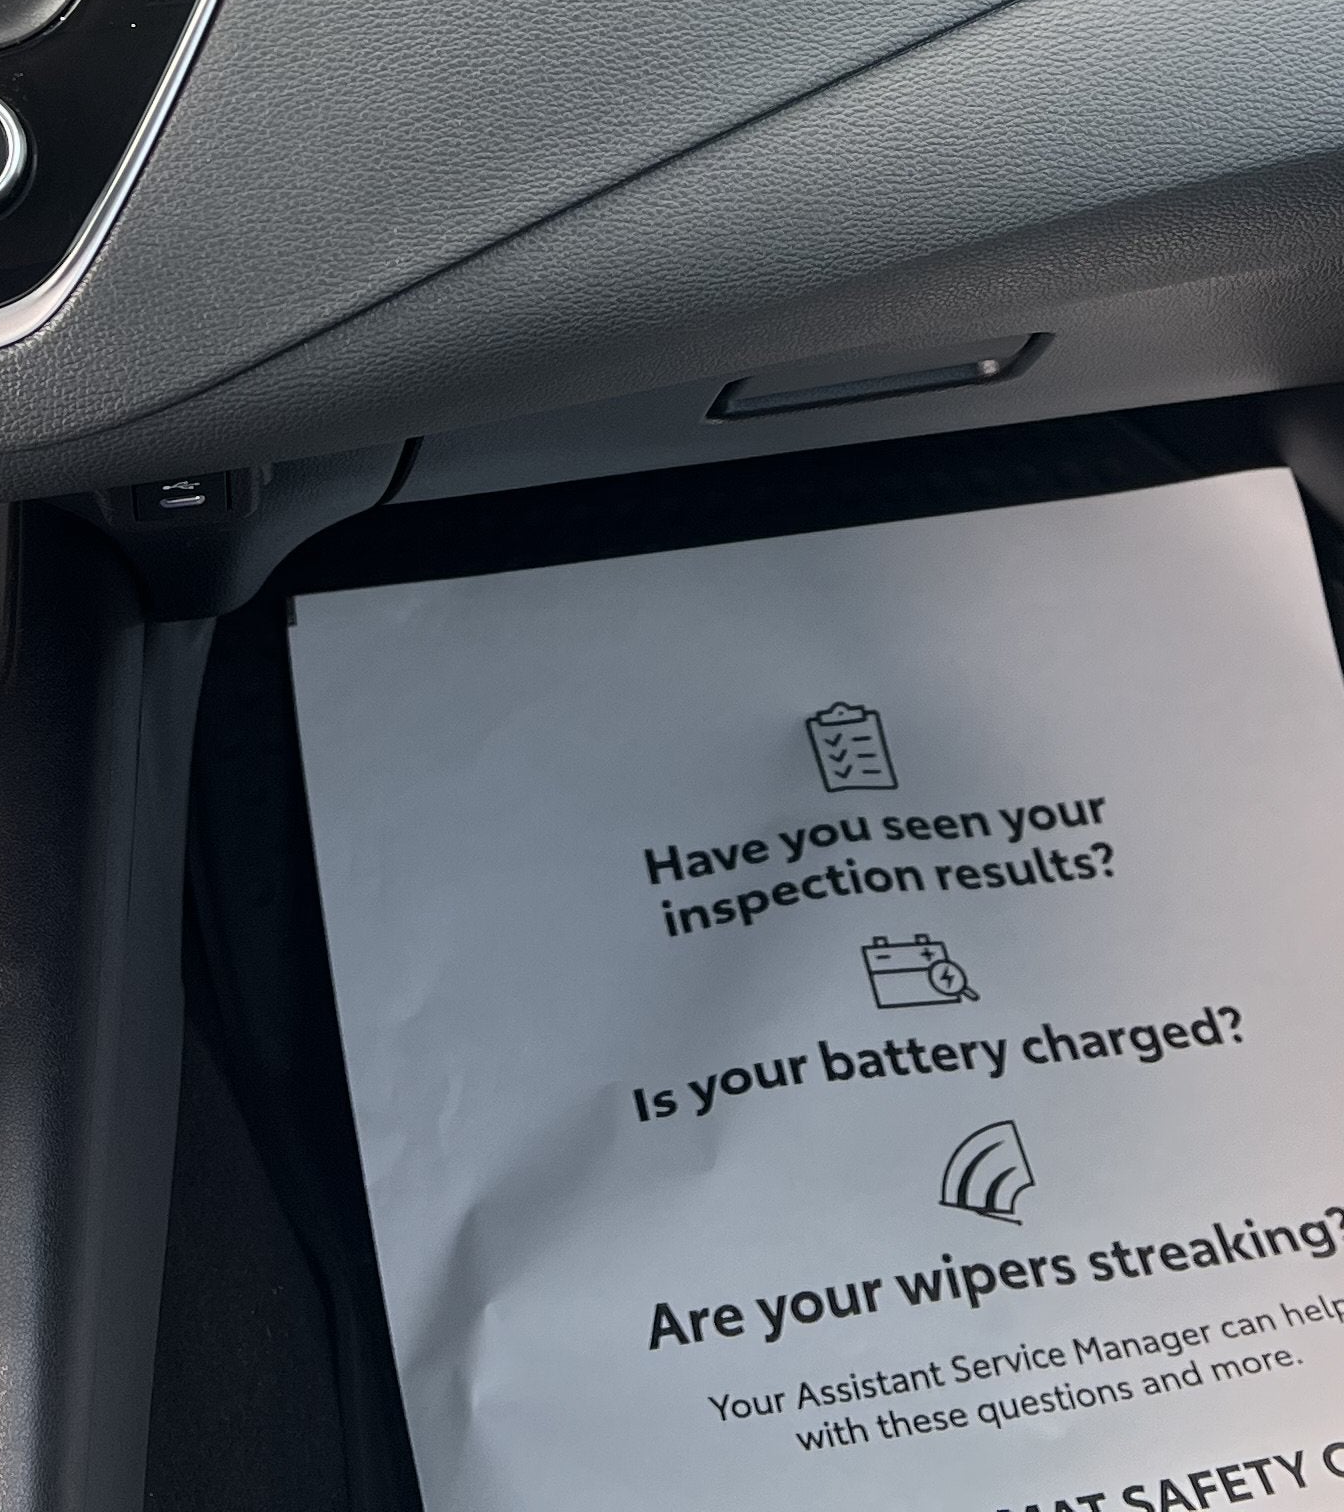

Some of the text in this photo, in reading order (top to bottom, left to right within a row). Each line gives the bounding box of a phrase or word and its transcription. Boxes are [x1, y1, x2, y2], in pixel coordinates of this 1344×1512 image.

[643, 796, 1106, 885] Have you seen your
[661, 841, 1116, 937] inspection results?
[633, 1005, 1245, 1122] Is your battery charged?
[649, 1302, 745, 1350] Are
[756, 1277, 883, 1344] your
[894, 1252, 1077, 1309] wipers
[708, 1391, 786, 1422] Your
[797, 1361, 945, 1410] Assistant
[951, 1343, 1067, 1383] Service
[1072, 1323, 1211, 1366] Manager
[1221, 1310, 1277, 1340] can
[796, 1348, 1304, 1451] with these questions and more.
[1122, 1449, 1308, 1512] SAFETY
